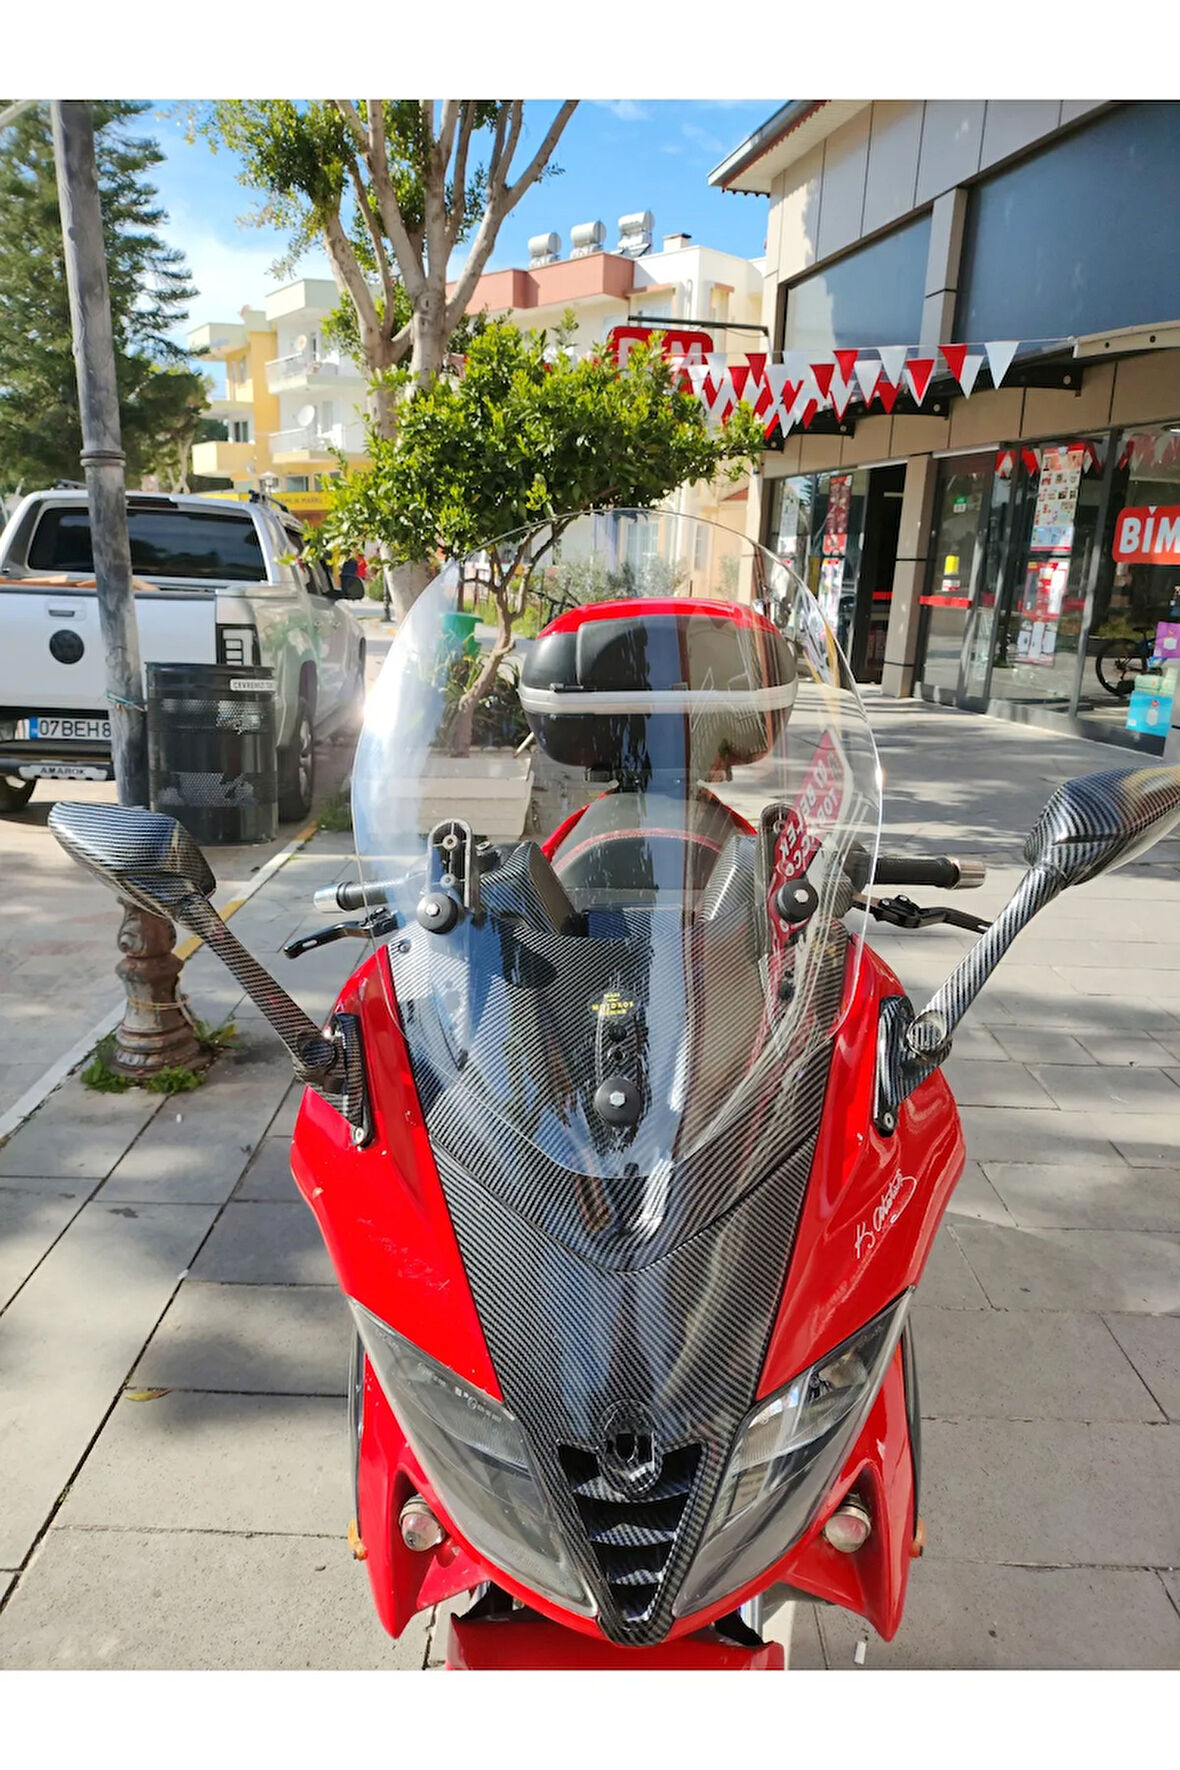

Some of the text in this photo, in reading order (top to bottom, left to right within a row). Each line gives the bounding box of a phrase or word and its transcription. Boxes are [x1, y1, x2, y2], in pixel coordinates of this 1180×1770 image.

[1119, 506, 1180, 554] BİM
[40, 720, 60, 736] 07
[62, 720, 99, 737] BEH
[41, 767, 87, 776] AMAROK
